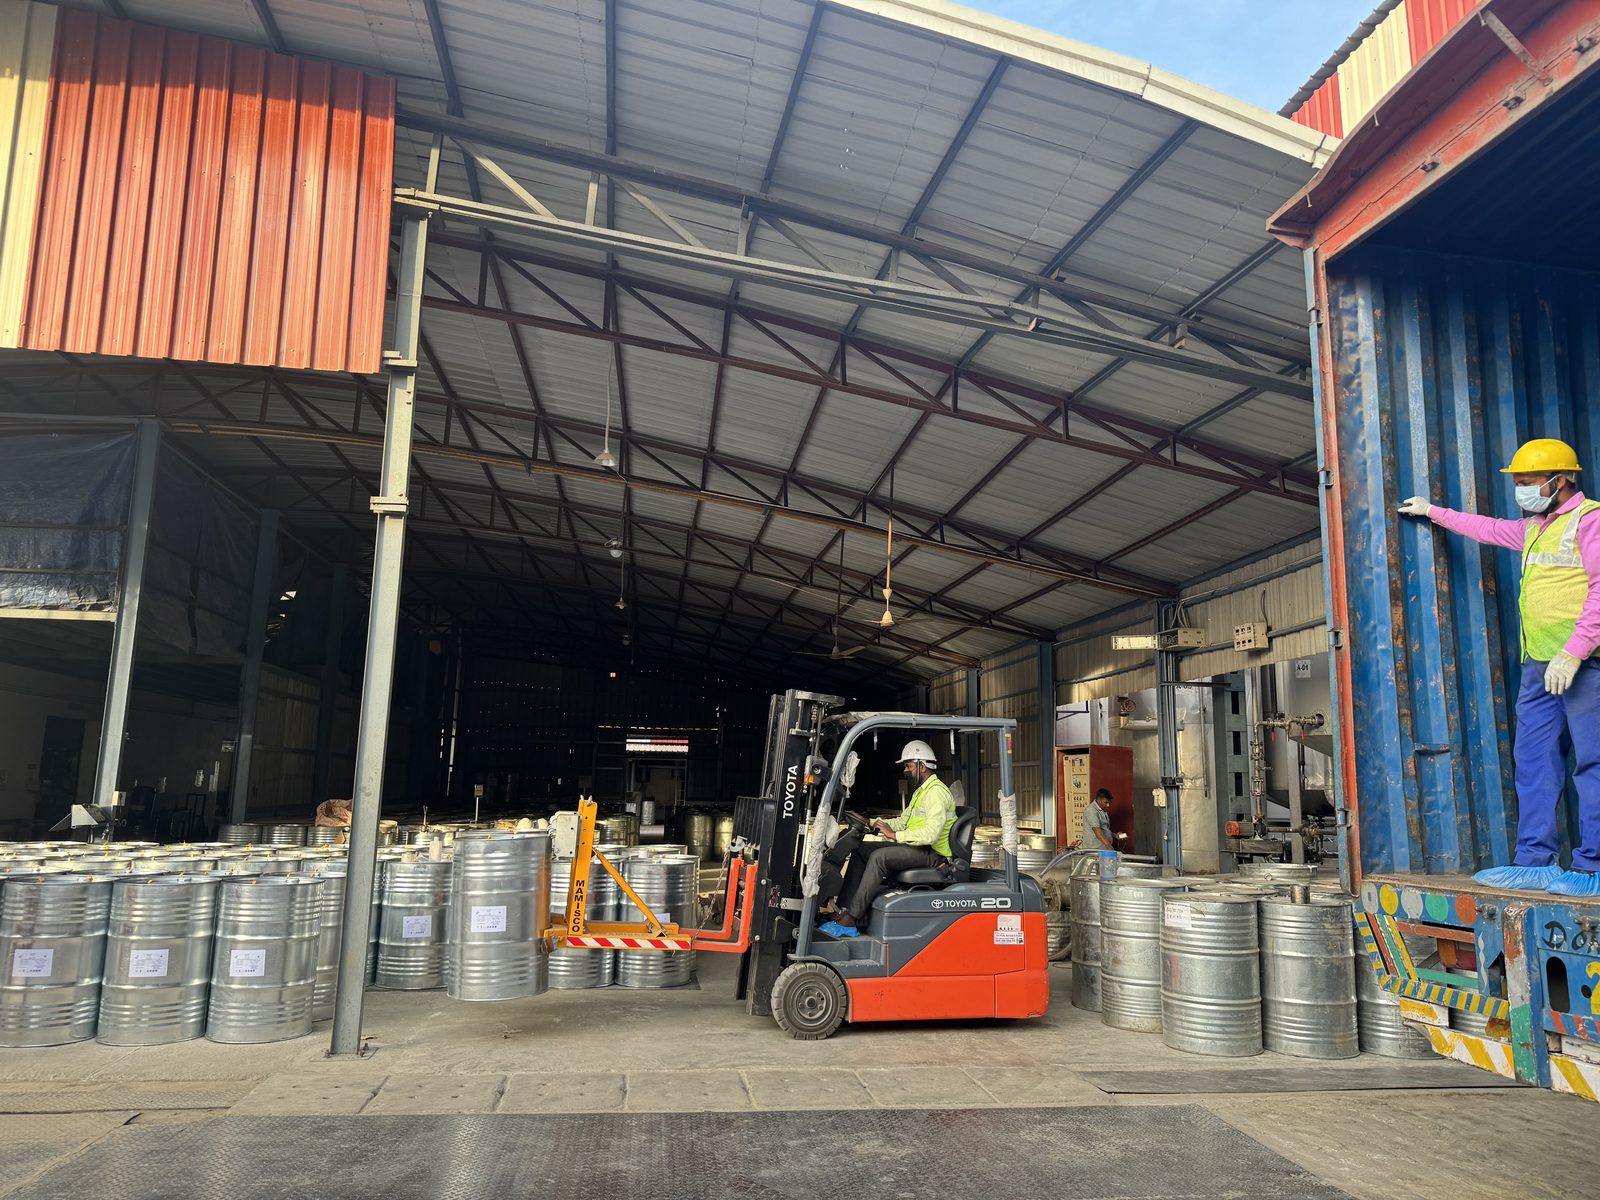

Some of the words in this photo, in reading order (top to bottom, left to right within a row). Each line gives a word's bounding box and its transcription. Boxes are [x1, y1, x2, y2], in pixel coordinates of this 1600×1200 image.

[782, 765, 798, 819] TOYOTA
[572, 880, 585, 932] MAMISCO
[944, 899, 977, 908] TOYOTA
[981, 897, 1011, 909] 20
